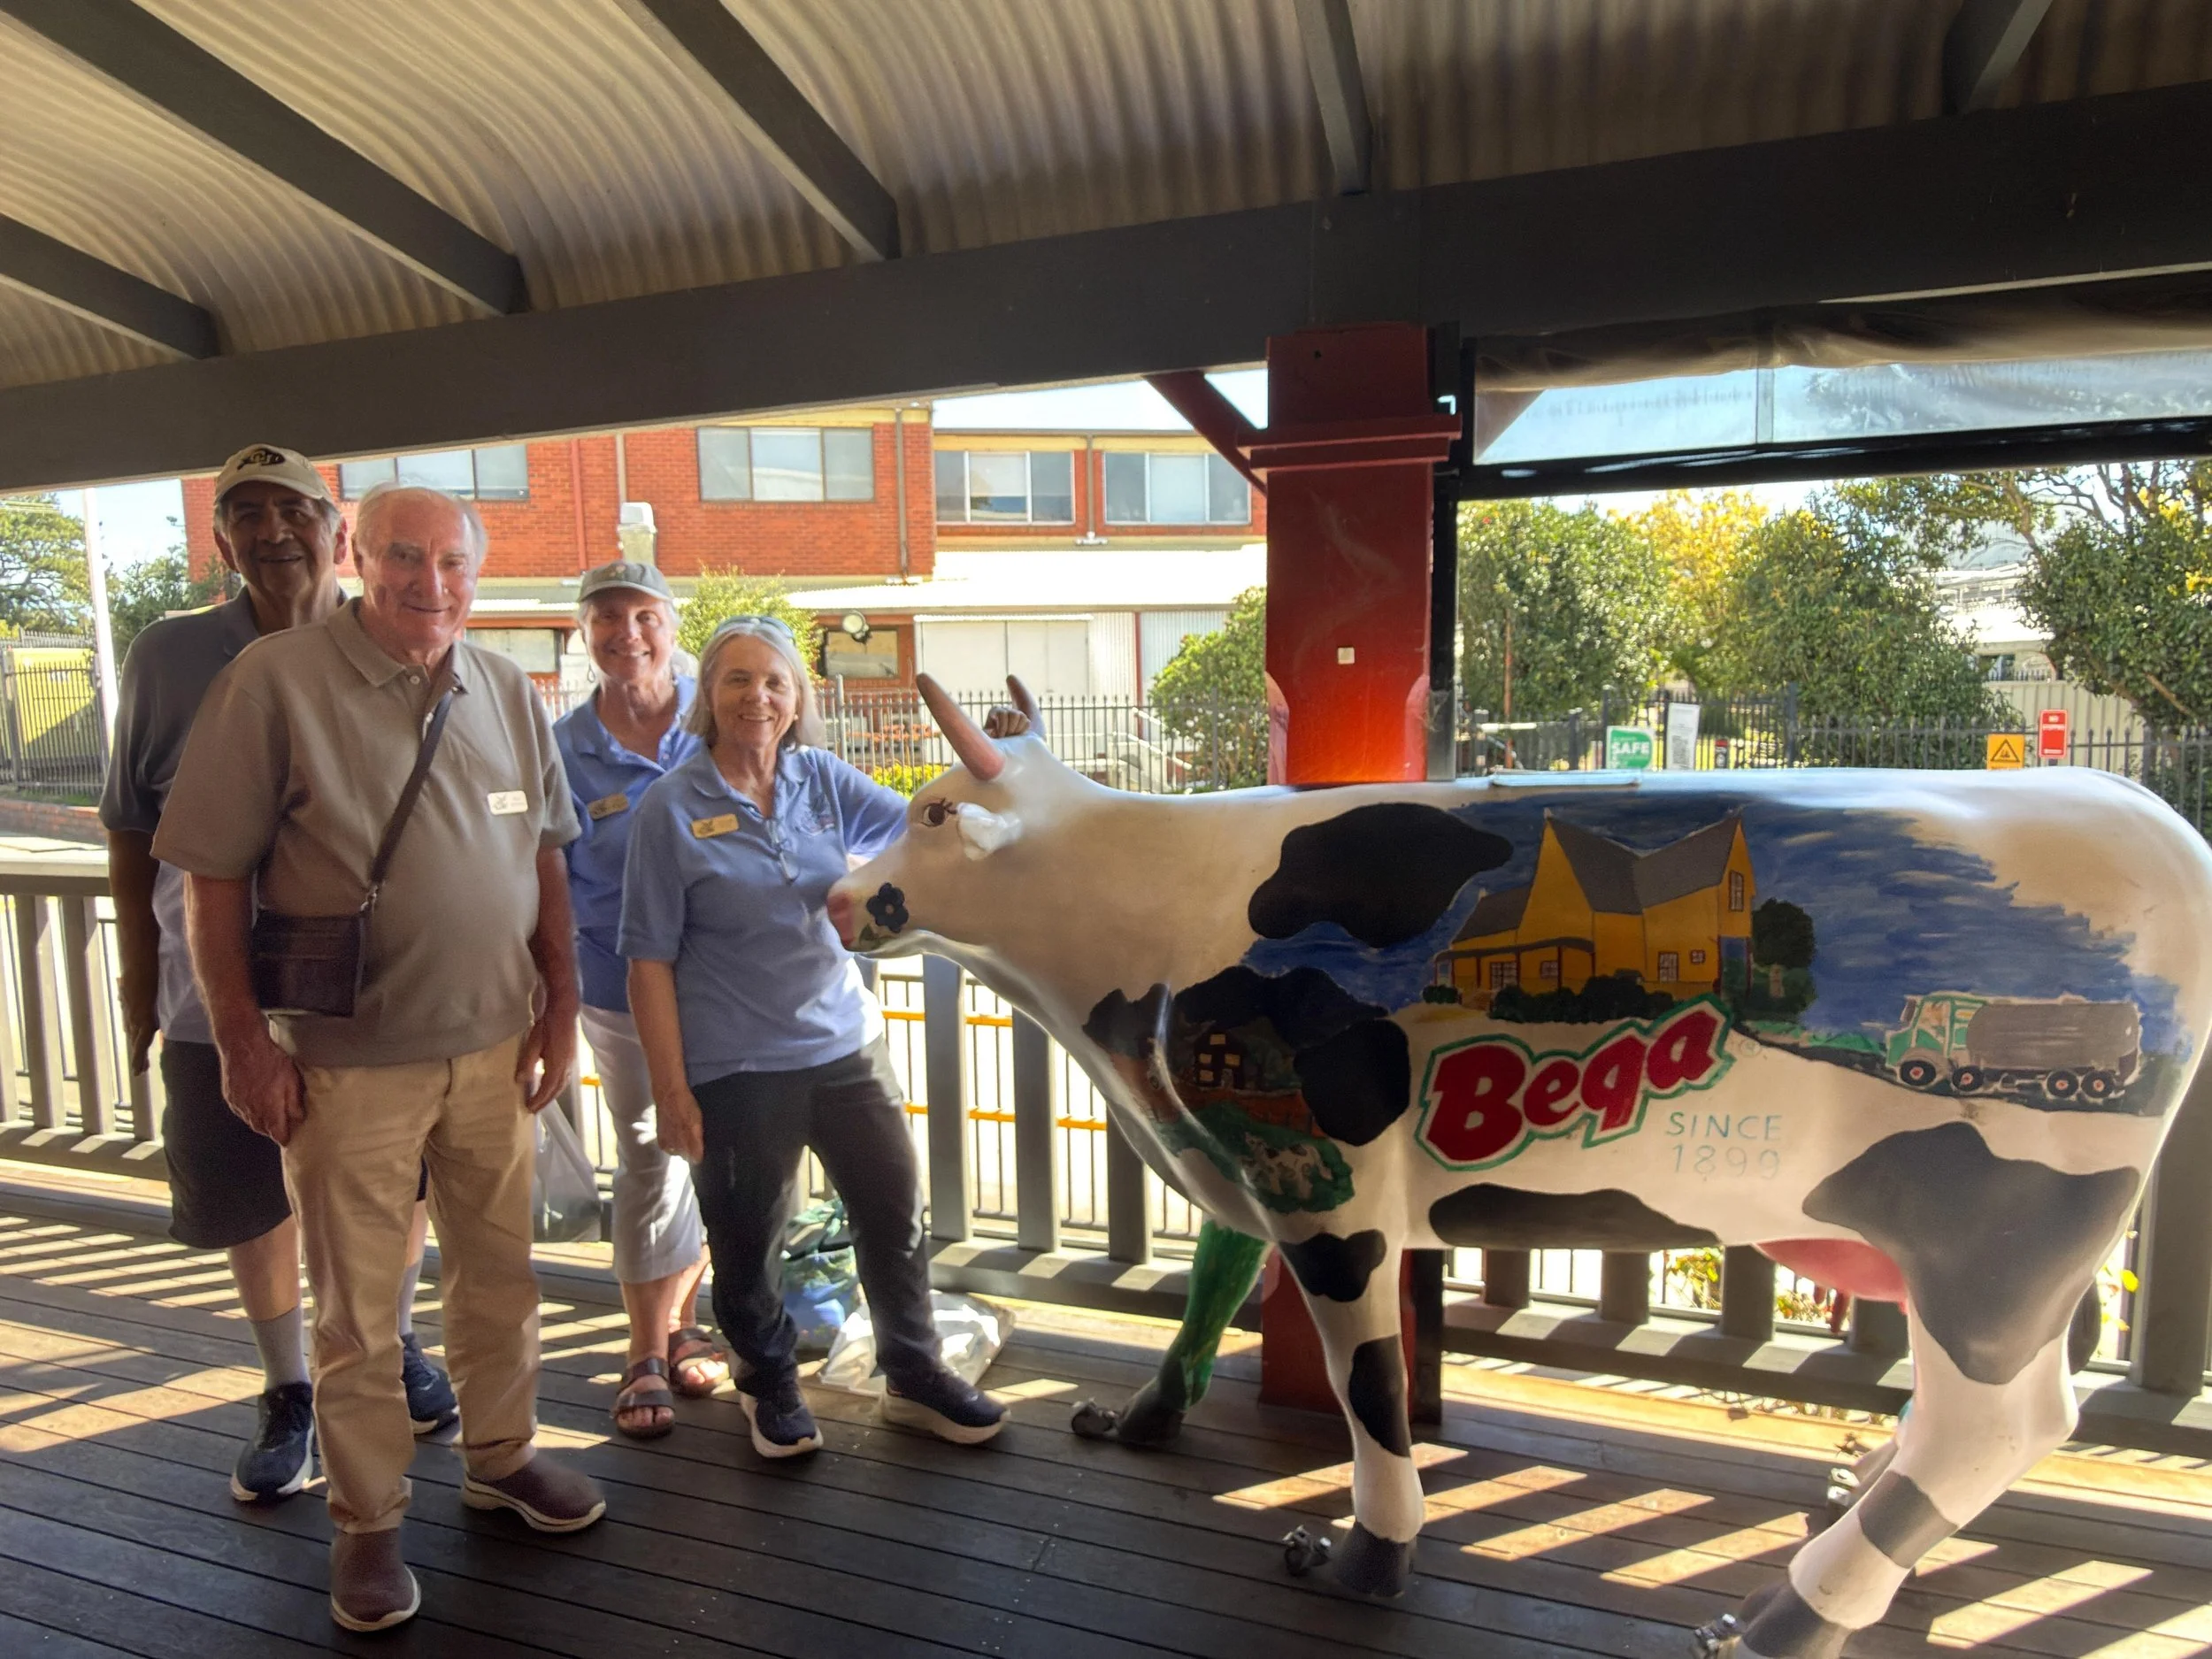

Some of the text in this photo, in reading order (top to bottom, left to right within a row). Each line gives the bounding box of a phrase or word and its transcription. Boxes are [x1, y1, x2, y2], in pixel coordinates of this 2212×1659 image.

[1425, 1009, 1719, 1162] Bega
[1667, 1111, 1782, 1141] SINCE
[1672, 1143, 1780, 1179] 1899
